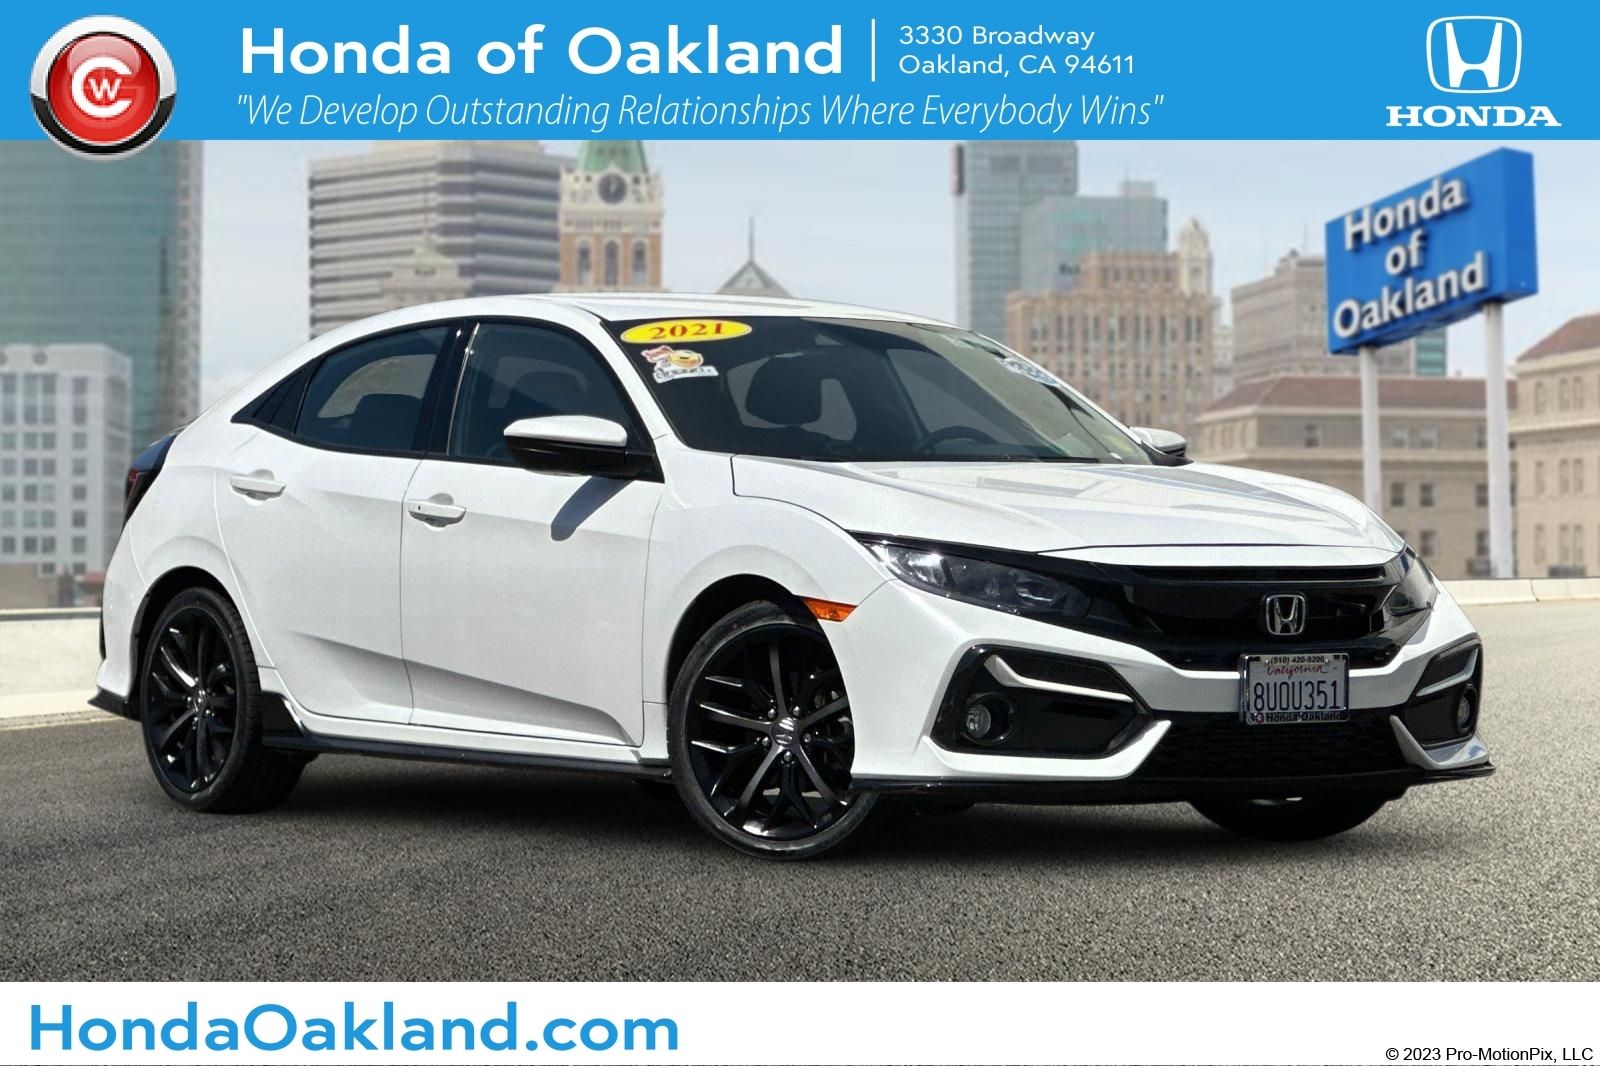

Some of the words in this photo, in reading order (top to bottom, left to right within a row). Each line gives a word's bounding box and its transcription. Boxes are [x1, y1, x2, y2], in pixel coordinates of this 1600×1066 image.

[1344, 177, 1466, 251] Honda
[1385, 229, 1426, 276] of
[1333, 252, 1489, 339] Oakland
[650, 322, 723, 340] 2021
[1266, 664, 1328, 679] California
